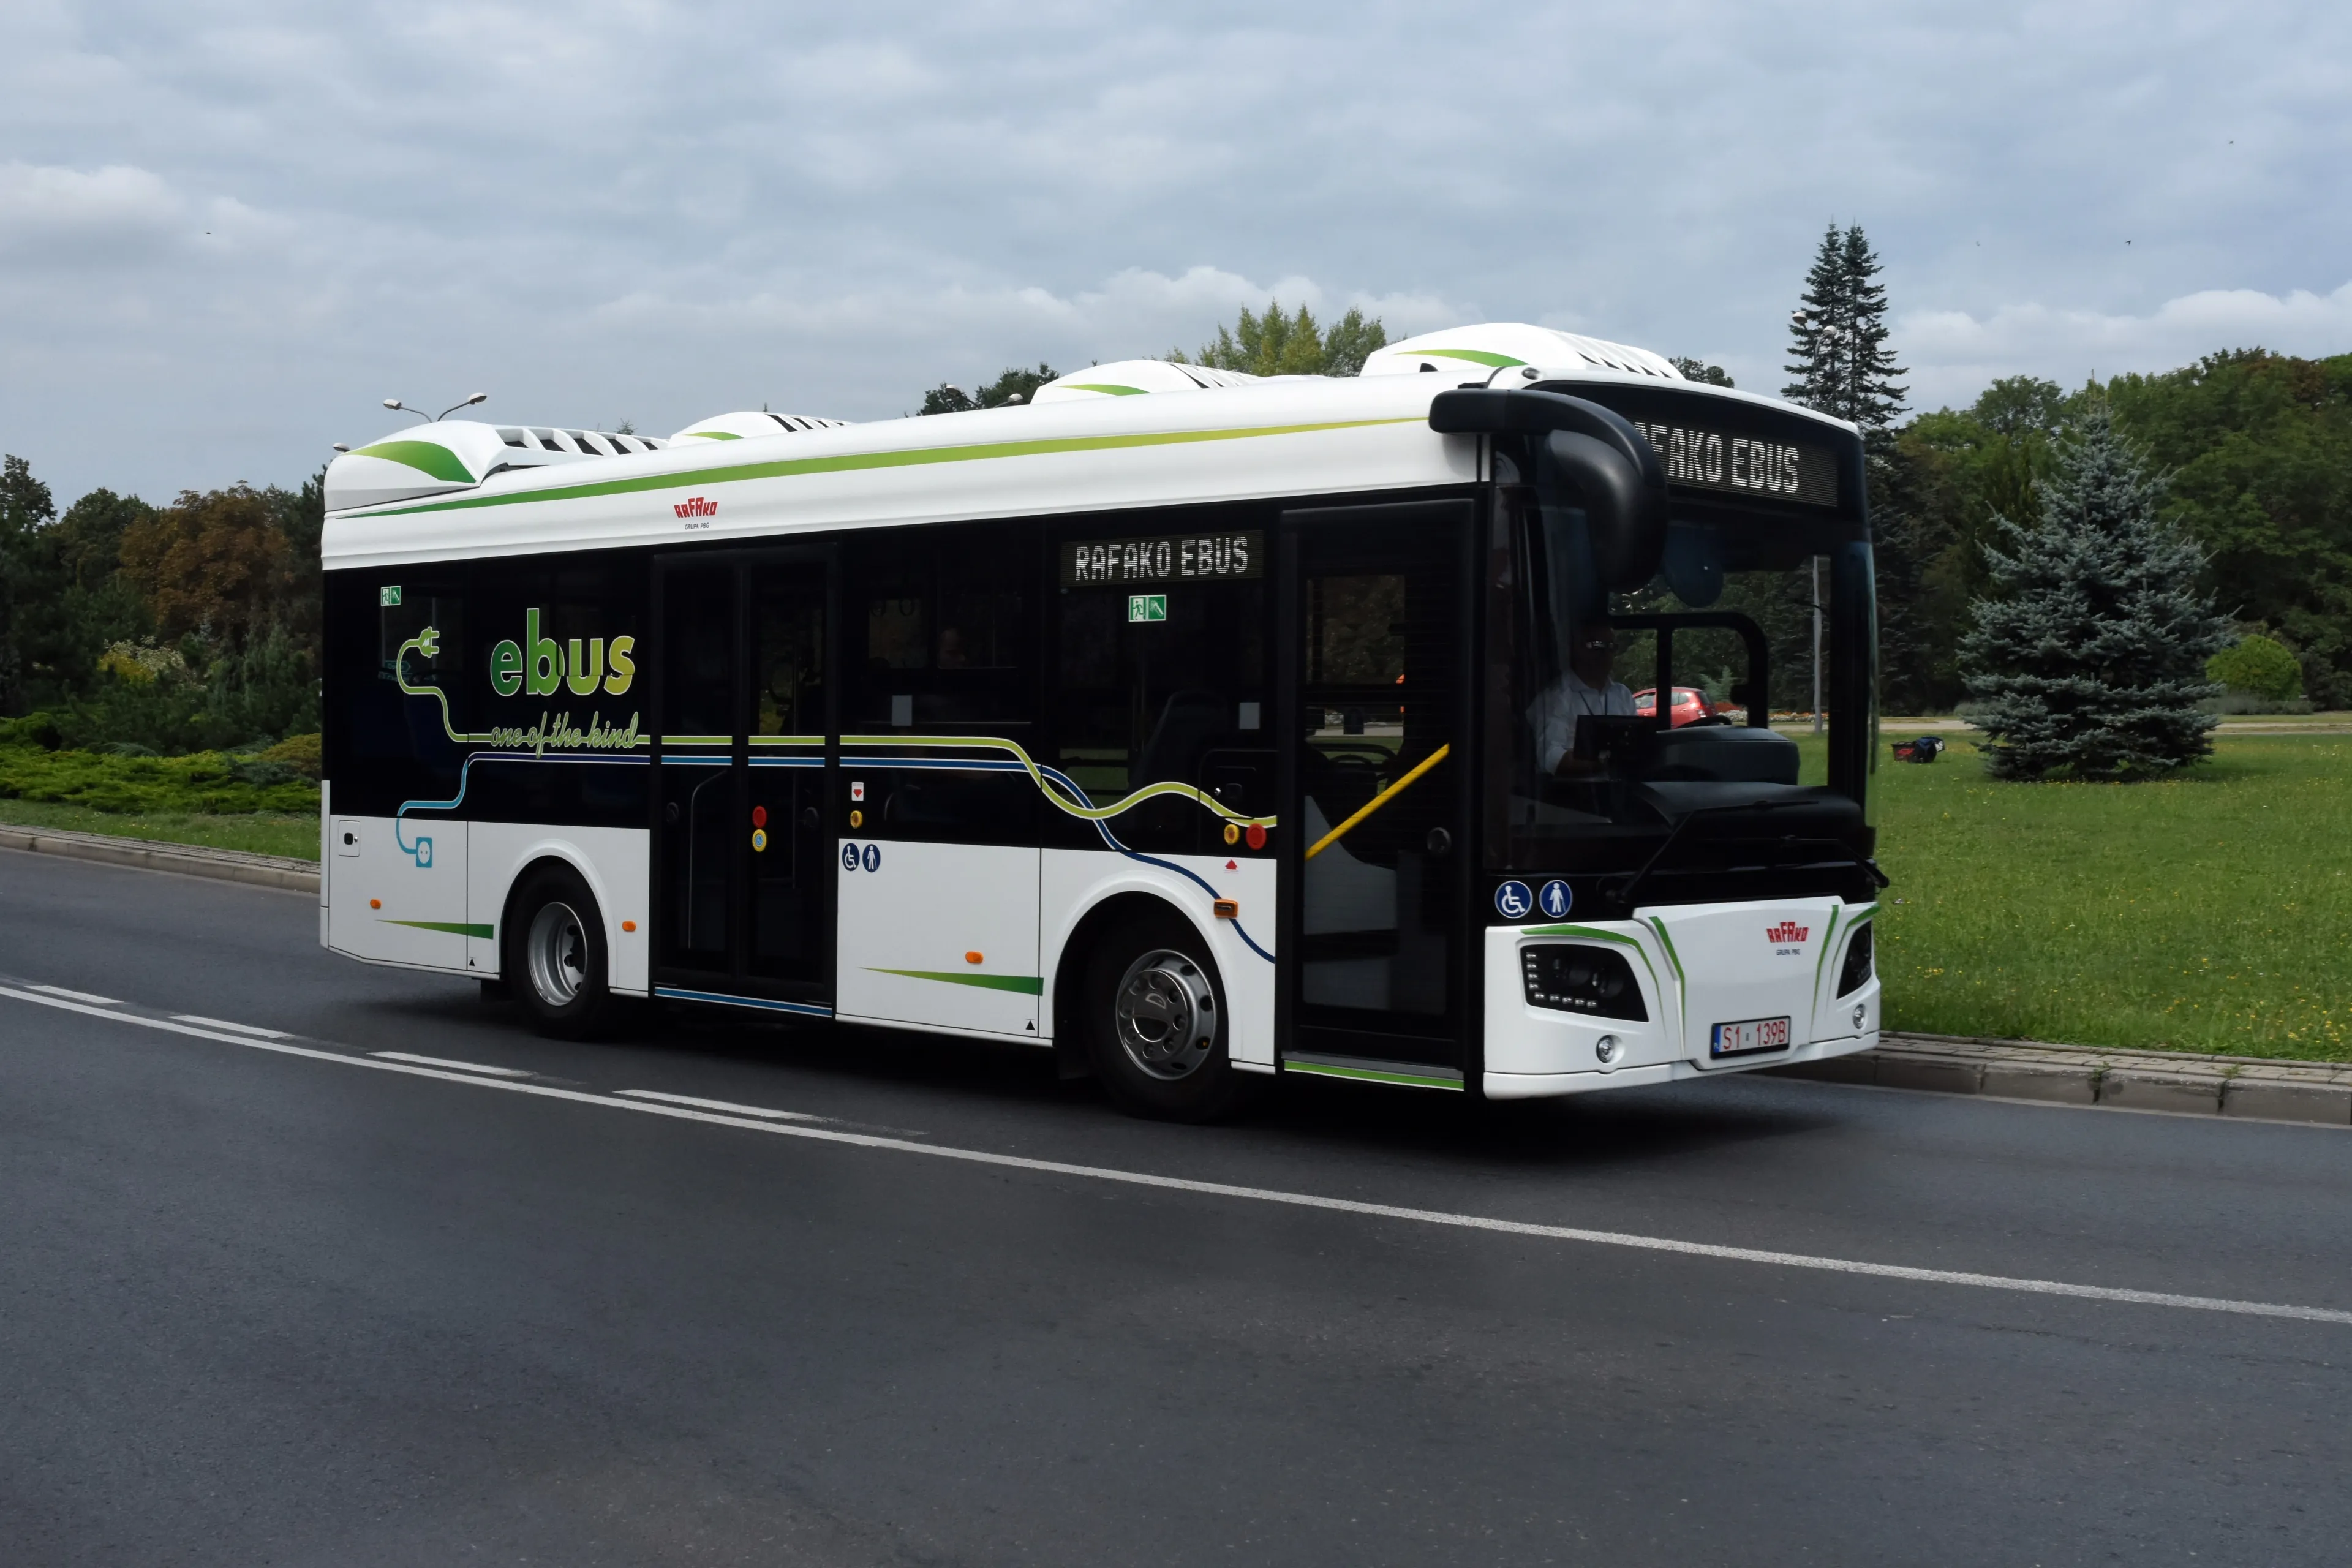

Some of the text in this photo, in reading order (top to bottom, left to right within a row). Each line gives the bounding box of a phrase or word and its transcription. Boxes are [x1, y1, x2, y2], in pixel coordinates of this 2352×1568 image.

[1634, 423, 1800, 494] FAKO EBUS
[674, 497, 718, 518] RAFAKO
[1076, 537, 1248, 581] RAFAKO EBUS
[491, 608, 635, 696] ebus
[491, 711, 639, 759] one of the kind
[1766, 921, 1809, 943] RAFAKO
[1723, 1020, 1786, 1050] S1 139B
